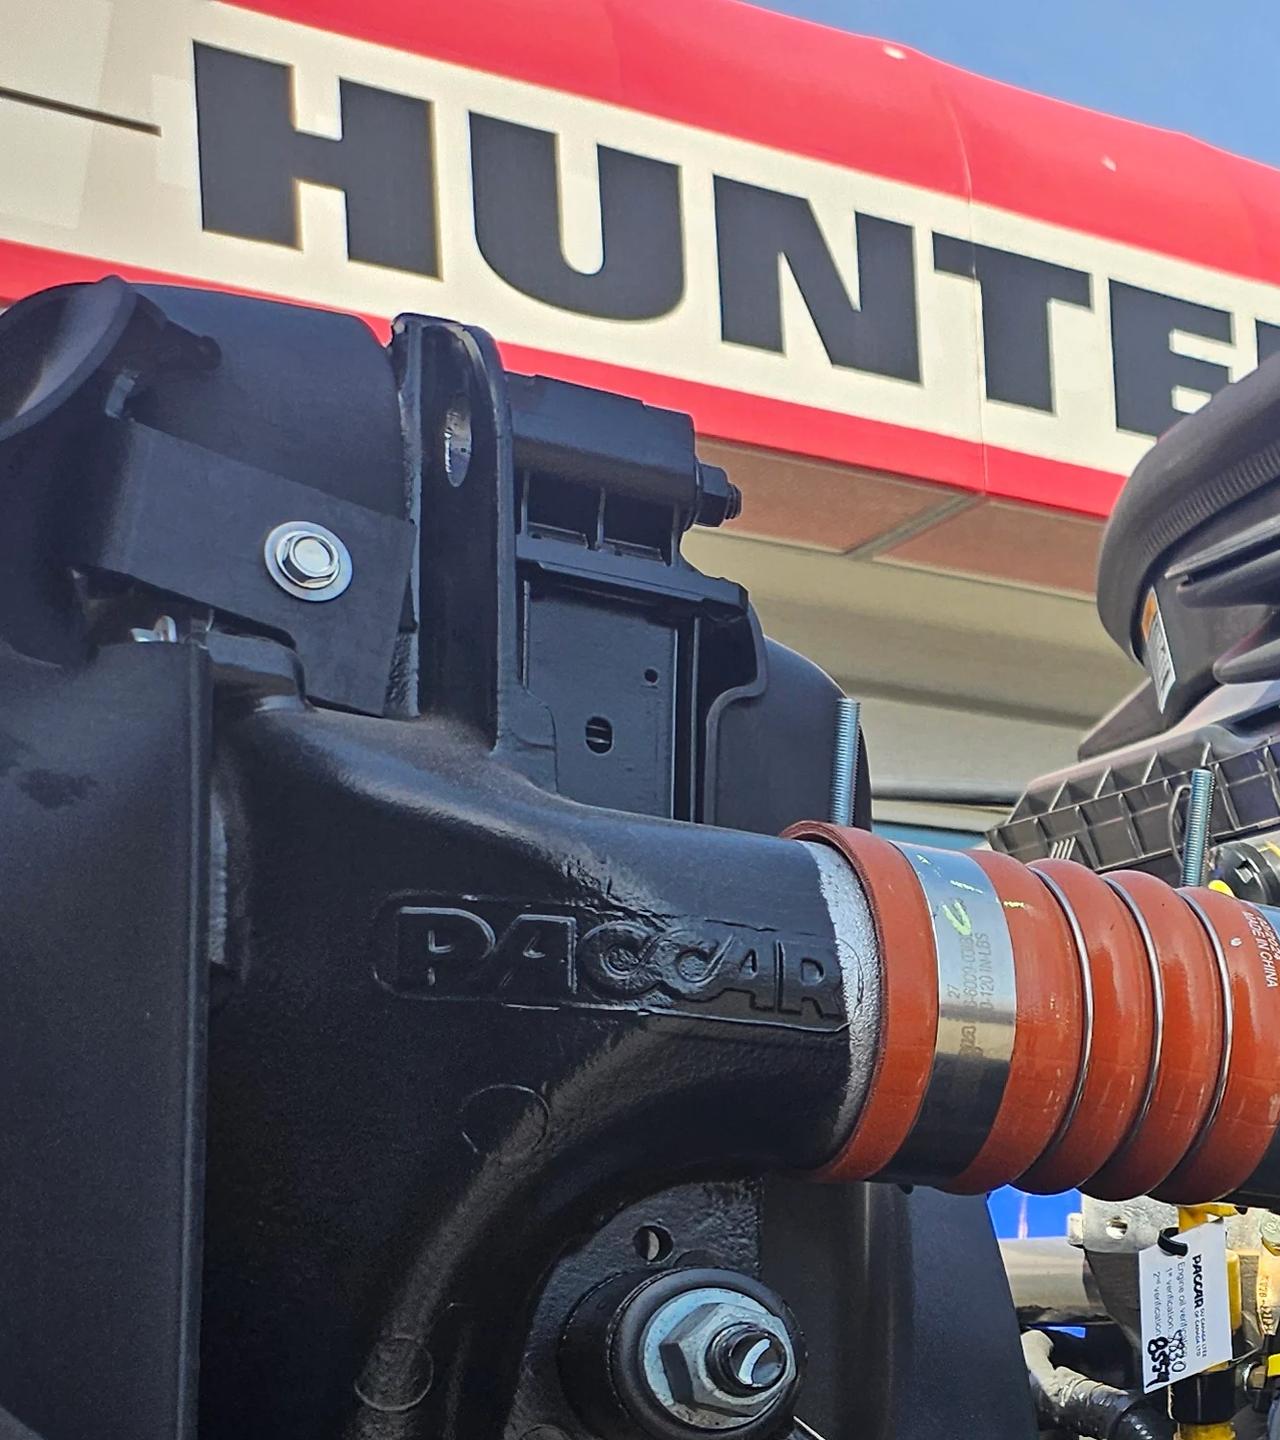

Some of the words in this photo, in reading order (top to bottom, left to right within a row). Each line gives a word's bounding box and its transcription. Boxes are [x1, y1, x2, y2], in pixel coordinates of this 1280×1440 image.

[398, 903, 852, 1019] PACCAR
[1260, 950, 1279, 988] CHINA
[1192, 1254, 1203, 1309] PACCAR
